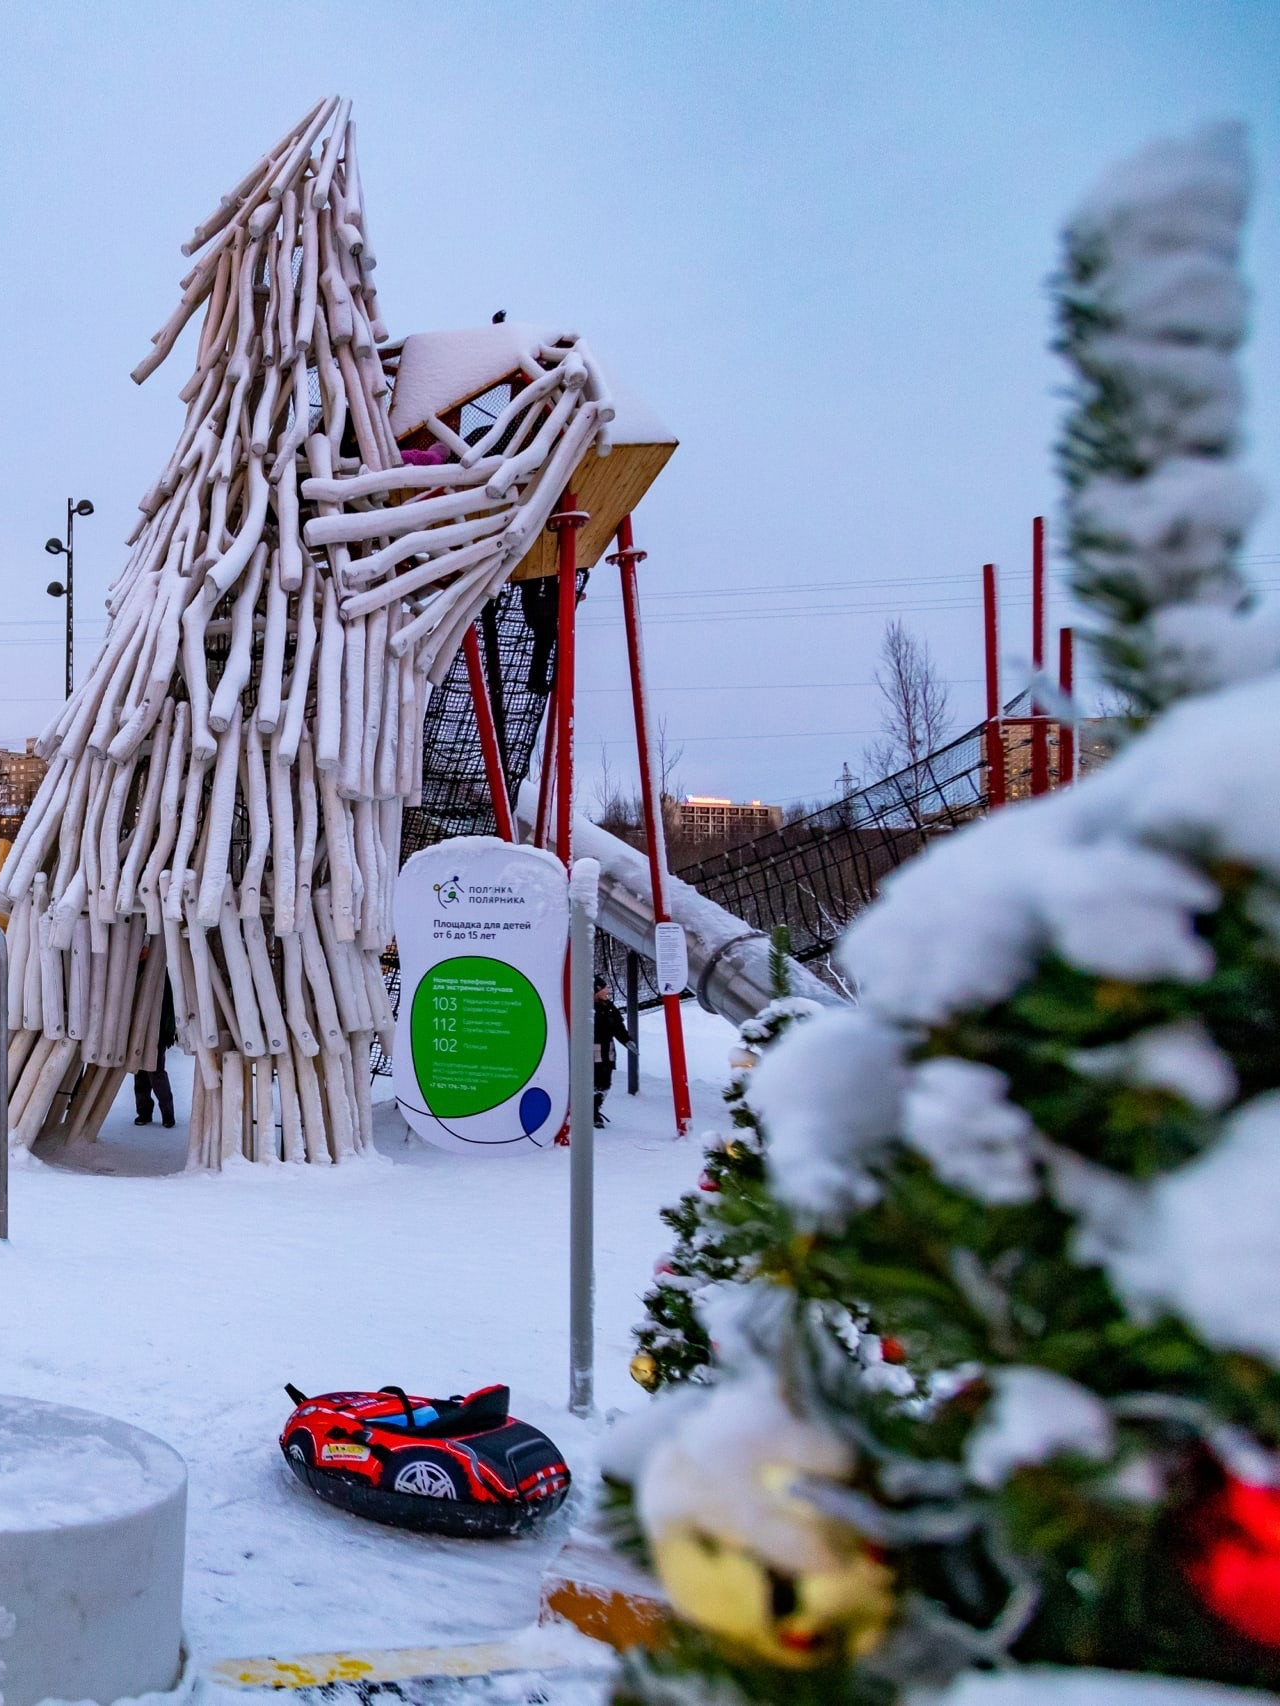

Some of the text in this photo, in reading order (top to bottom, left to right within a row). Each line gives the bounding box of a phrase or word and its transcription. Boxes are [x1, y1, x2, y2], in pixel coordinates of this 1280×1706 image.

[469, 886, 513, 894] ПОЛНКА
[469, 896, 525, 904] ПОЛЯРНИКА
[433, 919, 531, 930] Площадка для детей
[446, 930, 452, 939] 6
[454, 932, 466, 940] до
[468, 931, 478, 939] 15
[479, 932, 496, 940] лет
[433, 997, 457, 1011] 103
[433, 1017, 456, 1032] 112
[433, 1038, 457, 1052] 102
